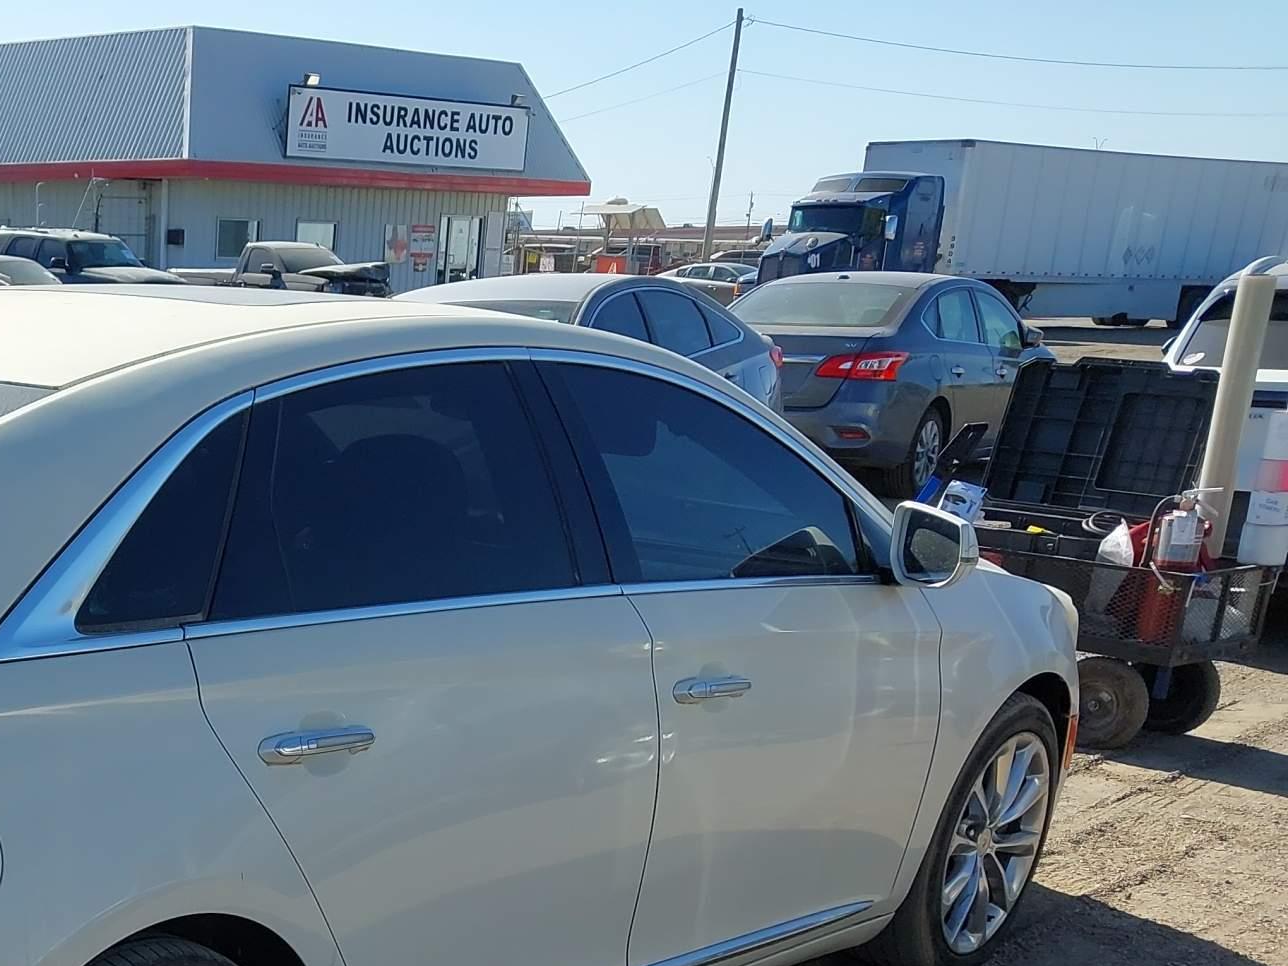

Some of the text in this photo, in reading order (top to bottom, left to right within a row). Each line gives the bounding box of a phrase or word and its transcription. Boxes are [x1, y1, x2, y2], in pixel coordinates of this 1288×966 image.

[347, 101, 514, 137] INSURANCE AUTO
[381, 132, 479, 160] AUCTIONS
